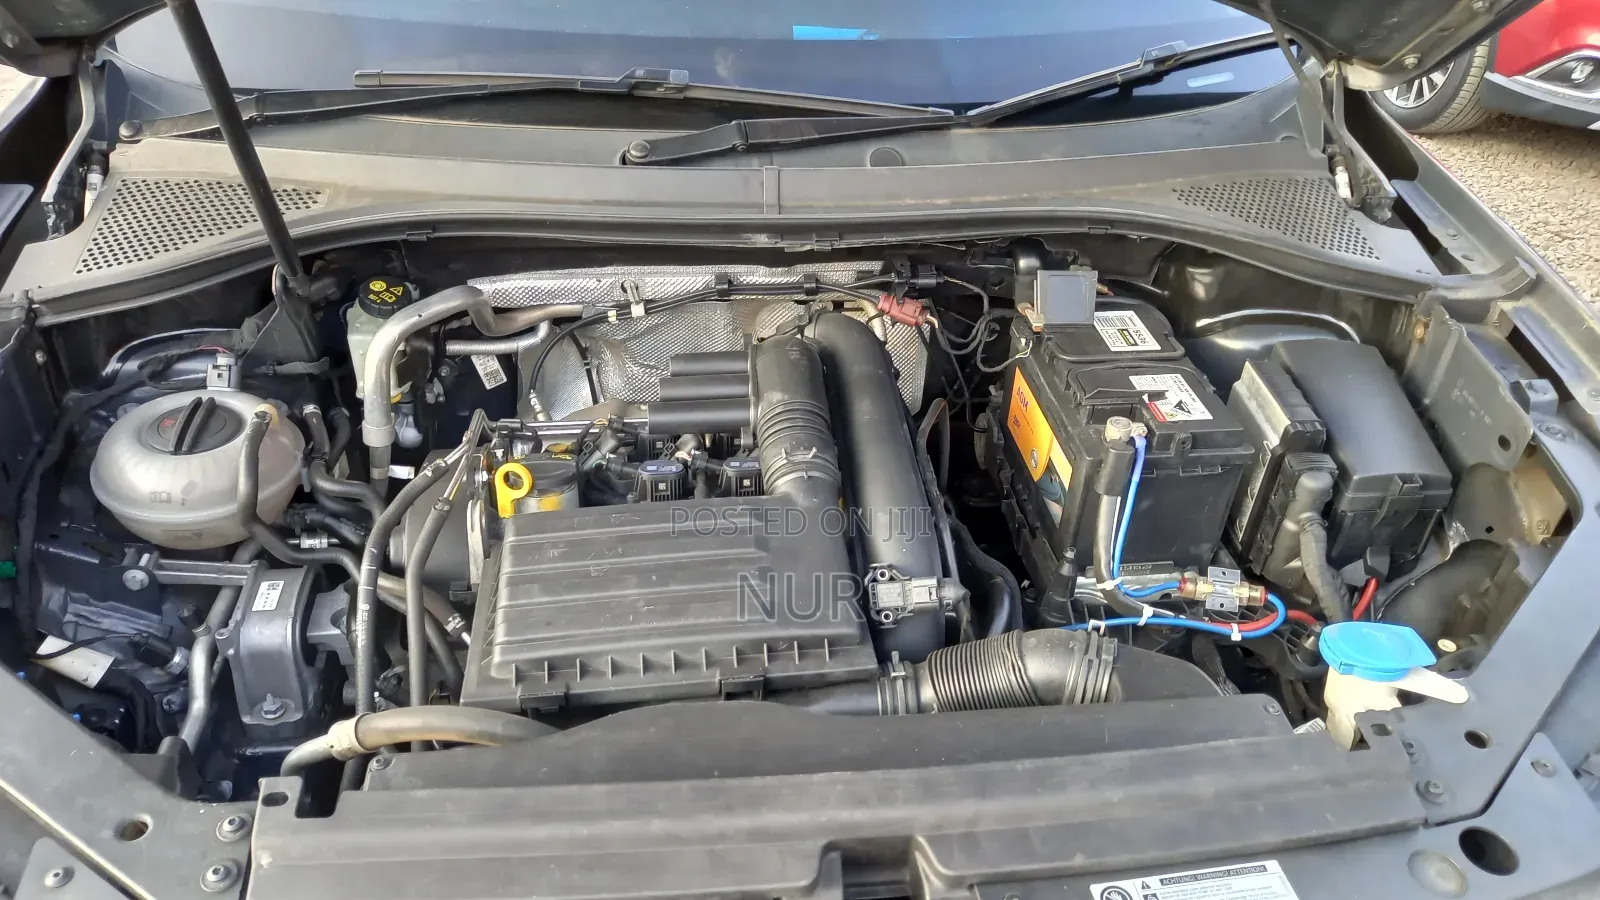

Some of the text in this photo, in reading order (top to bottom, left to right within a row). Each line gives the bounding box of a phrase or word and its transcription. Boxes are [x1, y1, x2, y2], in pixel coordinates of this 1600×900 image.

[1162, 866, 1266, 885] ACHTUNG! WARNING! ATTENTION!
